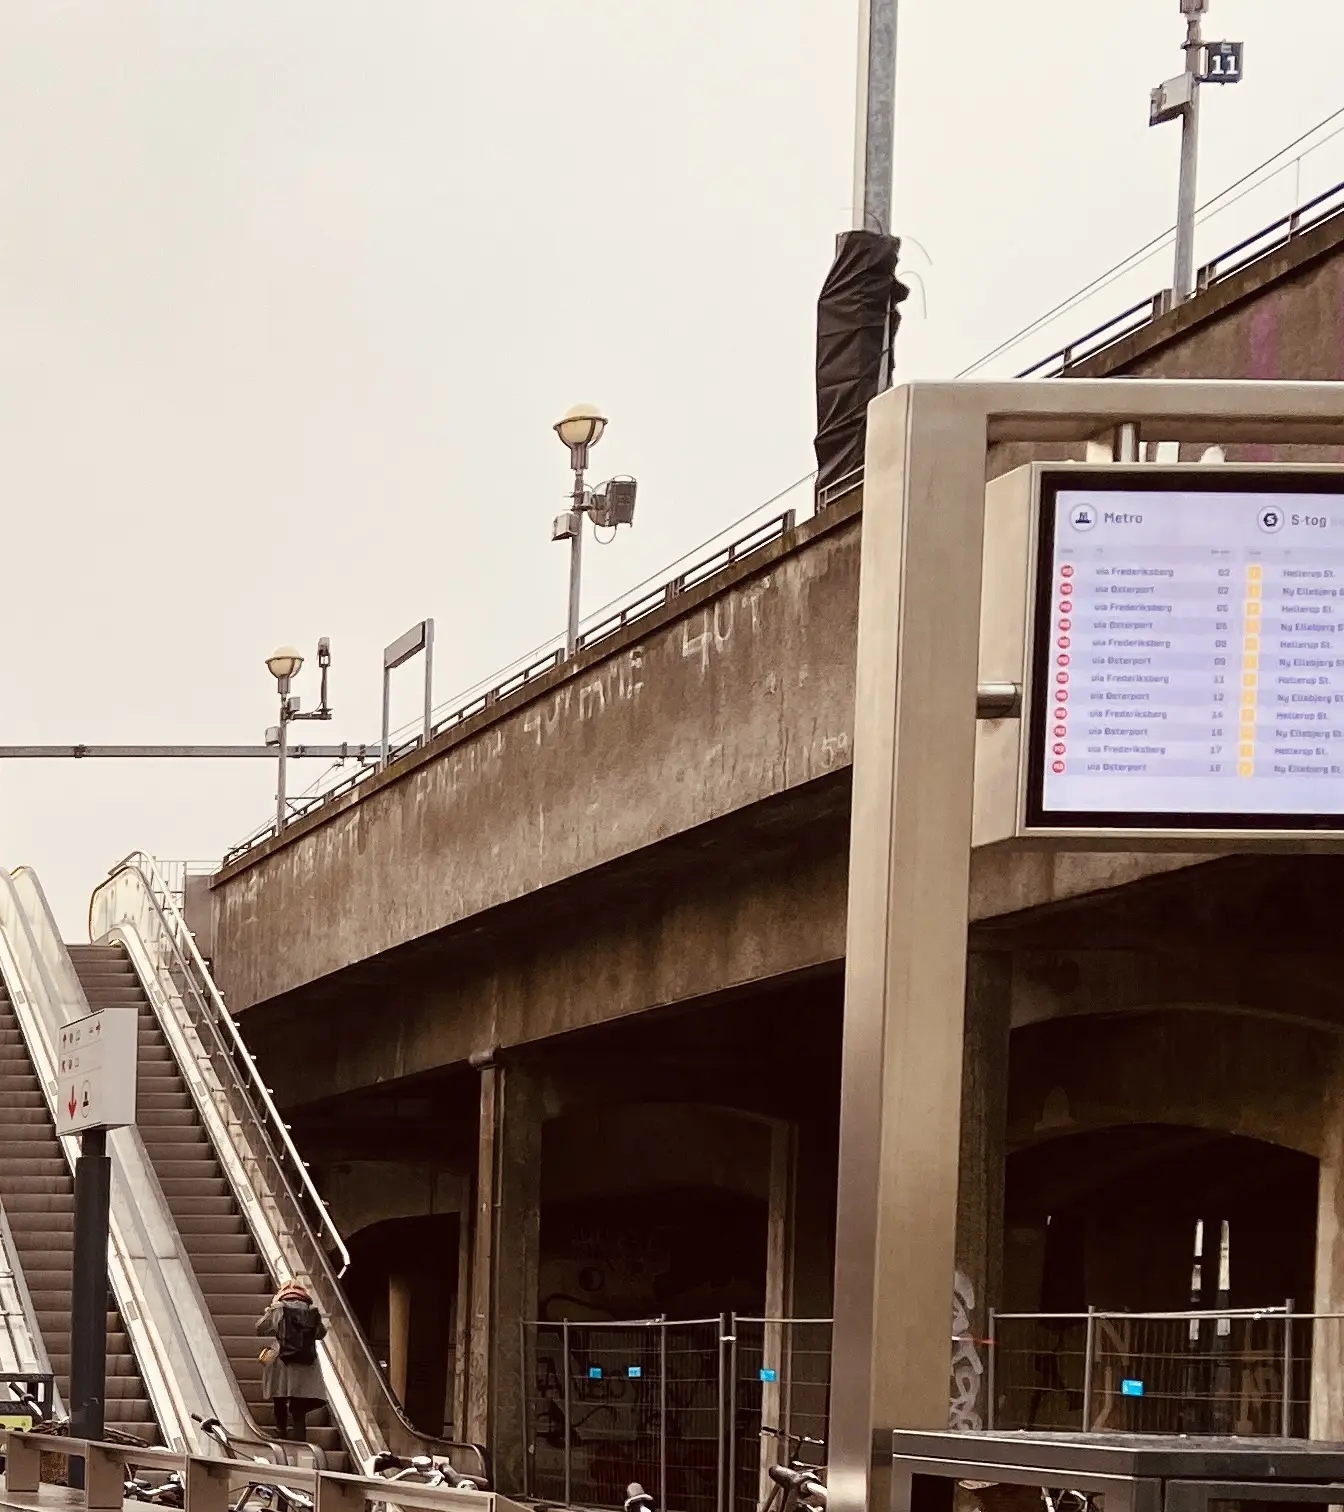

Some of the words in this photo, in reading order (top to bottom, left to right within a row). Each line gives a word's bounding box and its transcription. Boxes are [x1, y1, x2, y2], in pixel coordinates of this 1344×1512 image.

[1211, 55, 1238, 75] 11
[1104, 512, 1143, 524] Metro
[1291, 514, 1327, 528] S-tog
